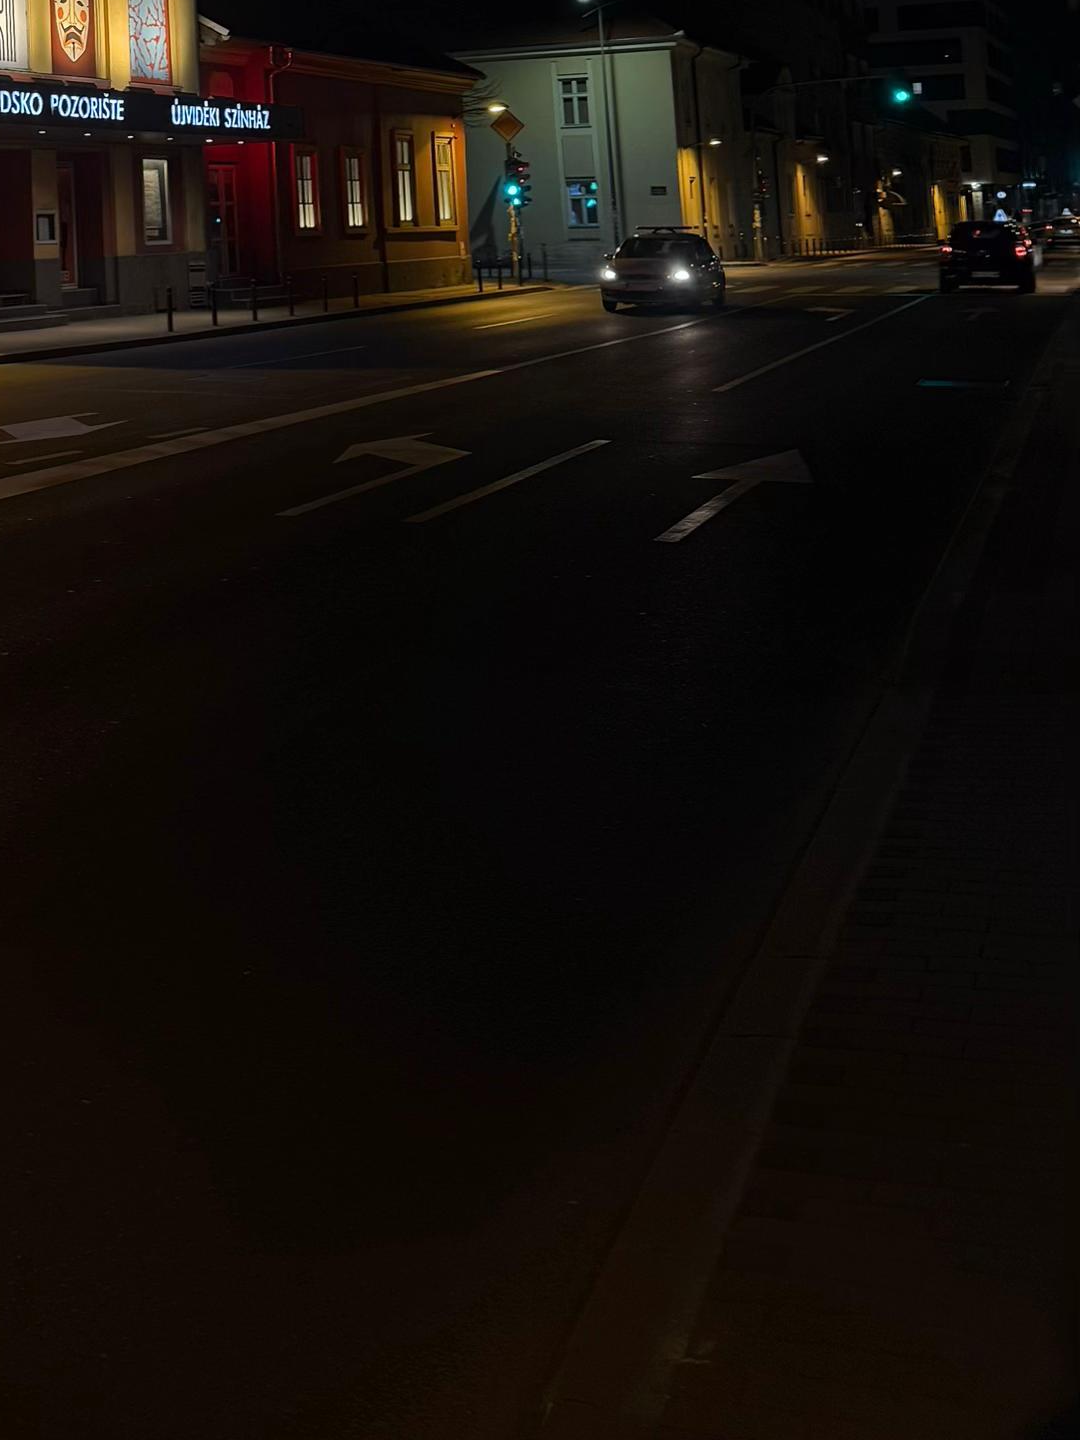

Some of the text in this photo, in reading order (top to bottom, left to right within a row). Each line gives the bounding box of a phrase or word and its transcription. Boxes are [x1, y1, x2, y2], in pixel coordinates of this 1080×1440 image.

[50, 92, 125, 121] POZORIŠTE
[171, 98, 271, 129] ÚJVIDÉKI SZÍNHÁZ
